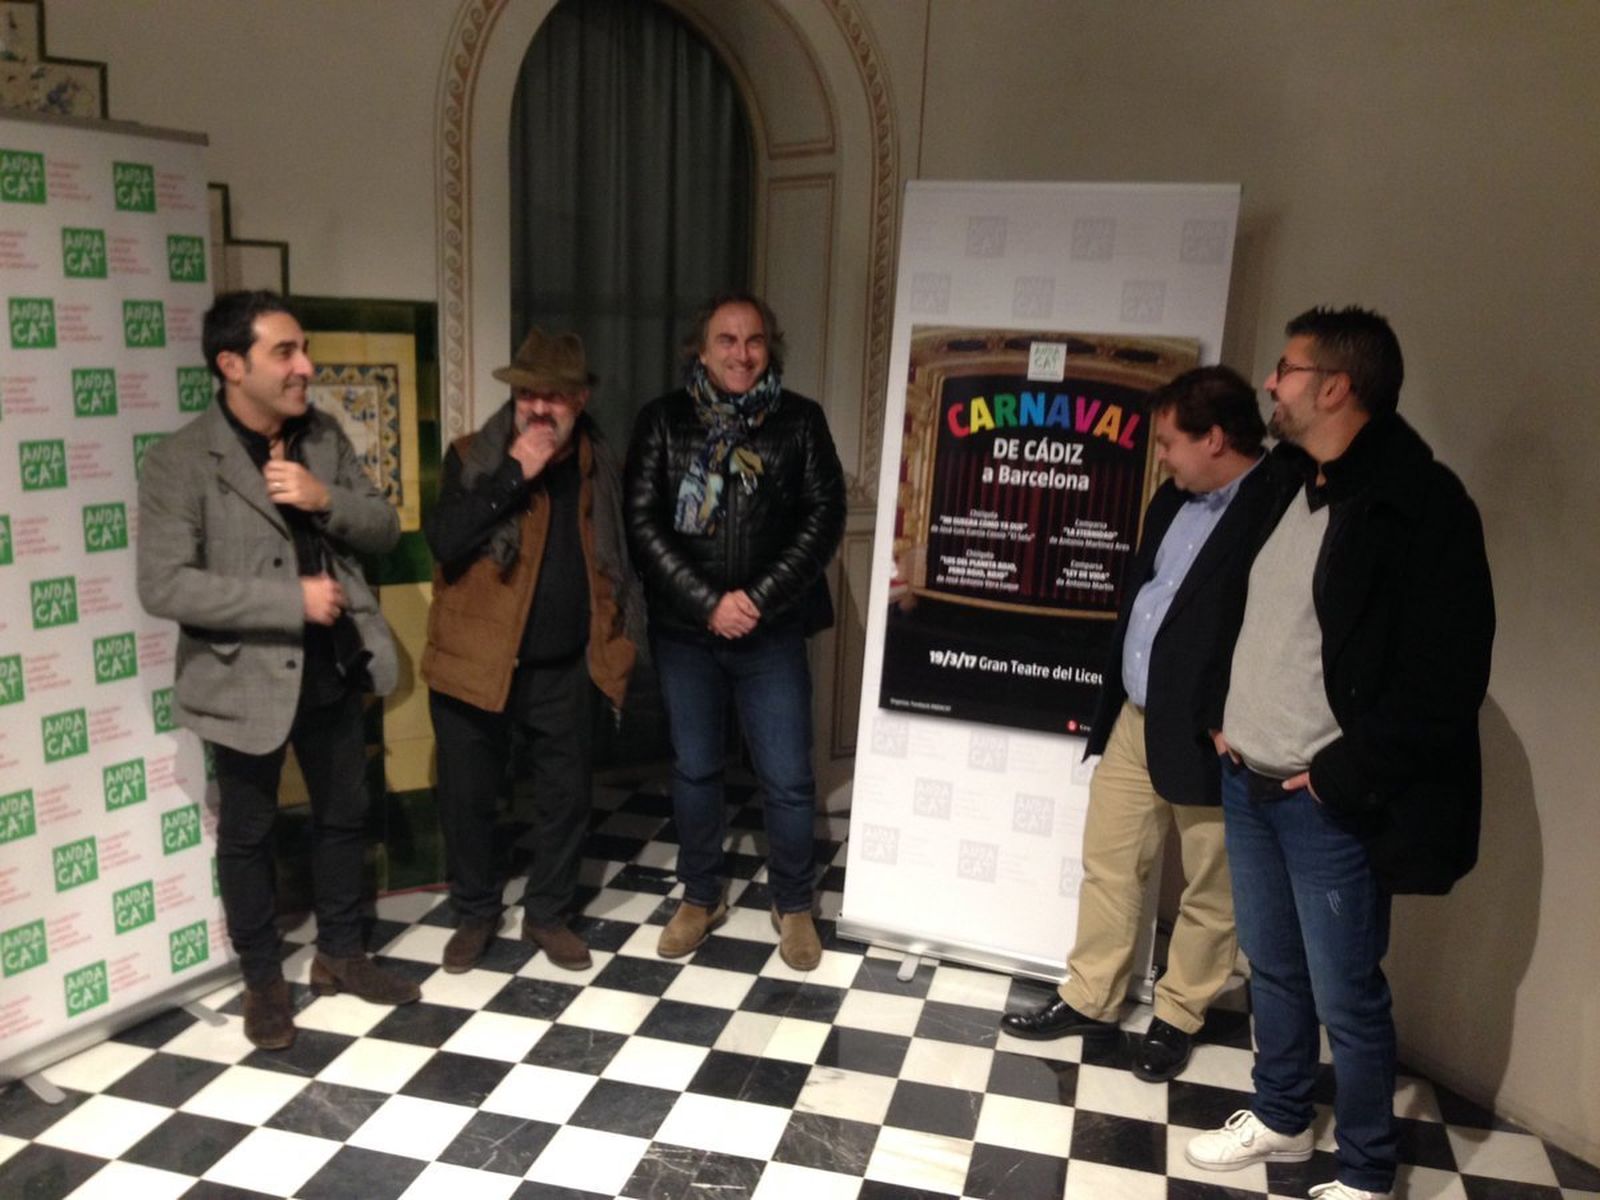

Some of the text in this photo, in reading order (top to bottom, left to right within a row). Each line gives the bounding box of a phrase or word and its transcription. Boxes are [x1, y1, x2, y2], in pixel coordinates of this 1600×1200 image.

[4, 175, 40, 196] CAT
[119, 186, 151, 206] CAT
[67, 252, 101, 271] CAT
[172, 258, 201, 276] CAT
[11, 302, 52, 319] ANDA
[125, 304, 161, 320] ANDA
[14, 323, 51, 342] CAT
[128, 324, 161, 341] CAT
[74, 372, 113, 389] ANDA
[78, 391, 112, 410] CAT
[181, 388, 209, 404] CAT
[947, 391, 1141, 449] CARNAVAL
[22, 444, 62, 463] ANDA
[993, 436, 1084, 466] DE CÁDIZ
[26, 464, 62, 484] CAT
[982, 464, 1090, 491] a Barcelona
[85, 507, 123, 526] ANDA
[88, 526, 122, 546] CAT
[34, 581, 73, 601] ANDA
[37, 600, 72, 622] CAT
[96, 636, 133, 658] ANDA
[99, 654, 132, 677] CAT
[929, 650, 977, 669] 19/3/17
[979, 656, 1008, 673] Gran
[1011, 660, 1050, 678] Teatre
[1052, 665, 1072, 681] del
[45, 712, 84, 736] ANDA
[48, 731, 83, 756] CAT
[106, 762, 142, 785] ANDA
[109, 779, 141, 804] CAT
[0, 793, 30, 814] NDA
[164, 807, 197, 831] ANDA
[166, 824, 196, 849] CAT
[55, 840, 93, 866] ANDA
[58, 859, 93, 885] CAT
[115, 884, 151, 909] ANDA
[118, 902, 150, 927] CAT
[3, 923, 42, 951] ANDA
[172, 924, 205, 949] ANDA
[6, 942, 42, 970] CAT
[175, 941, 204, 967] CAT
[67, 965, 104, 992] ANDA
[70, 982, 104, 1010] CAT
